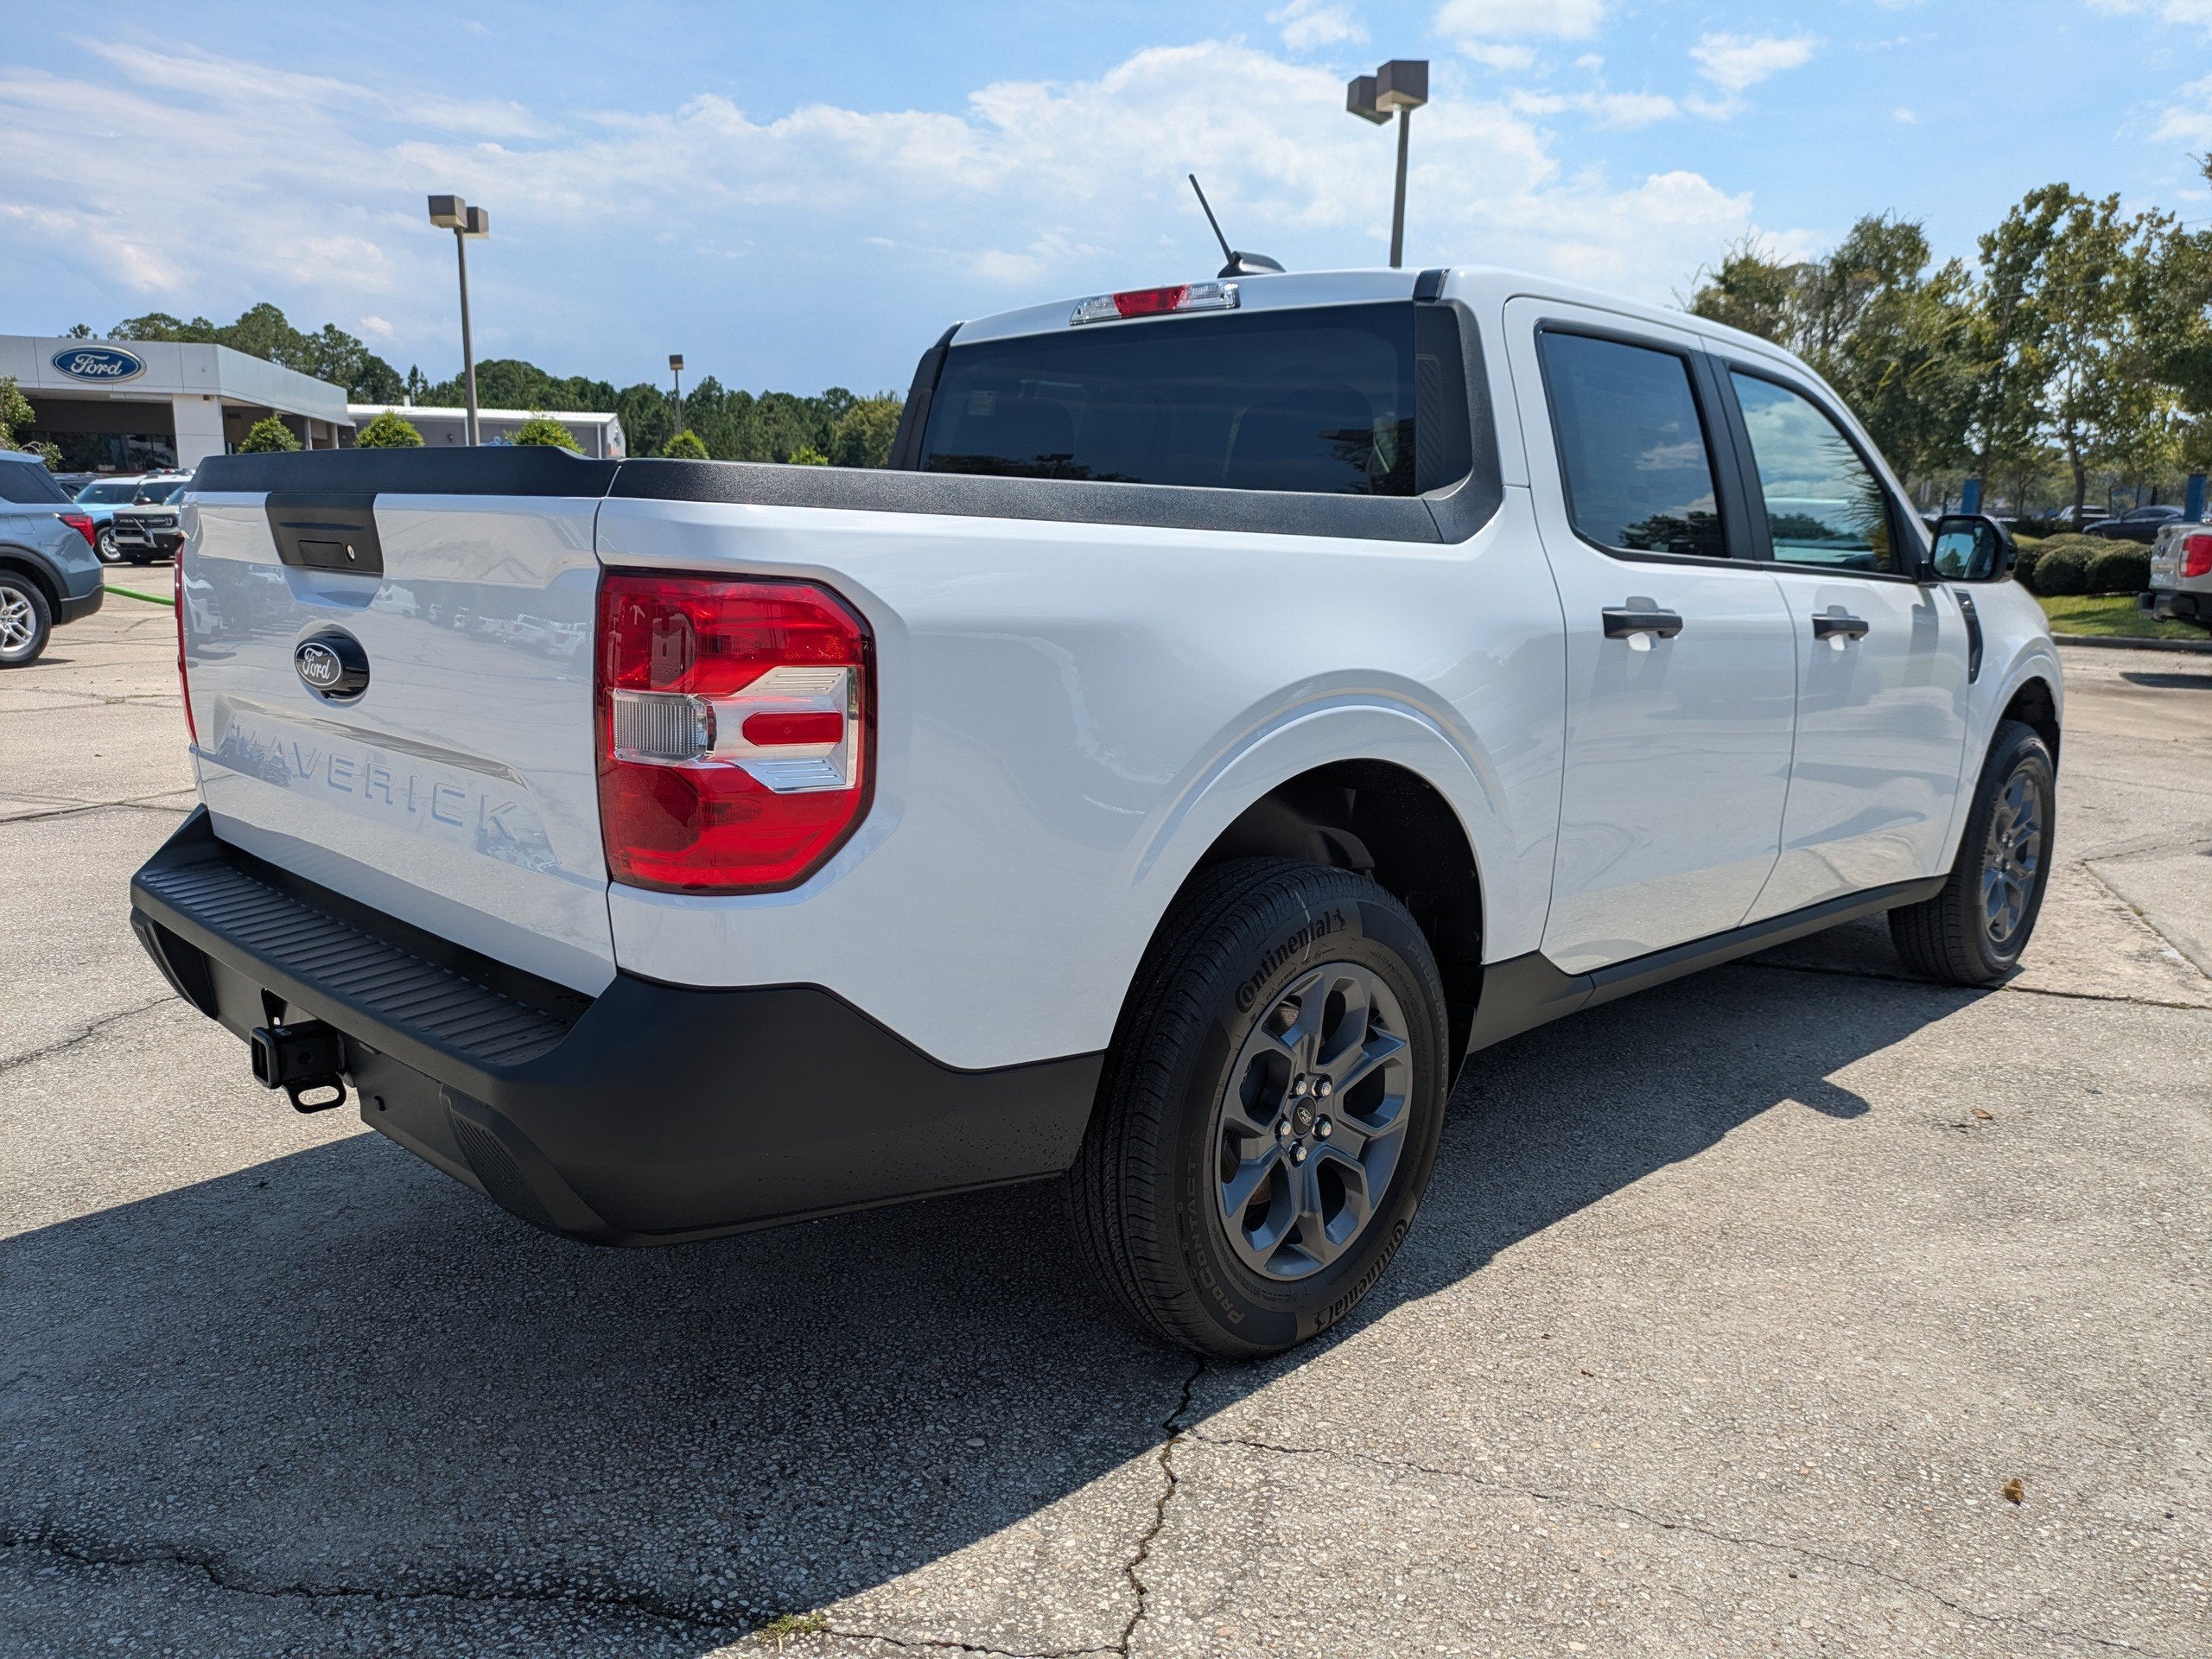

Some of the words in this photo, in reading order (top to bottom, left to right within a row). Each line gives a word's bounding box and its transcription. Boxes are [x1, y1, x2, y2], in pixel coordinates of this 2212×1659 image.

[70, 353, 122, 375] Ford
[302, 647, 331, 680] Ford
[234, 724, 518, 842] MAVERICK
[1235, 910, 1332, 1014] Continental
[1327, 1218, 1408, 1325] Continental
